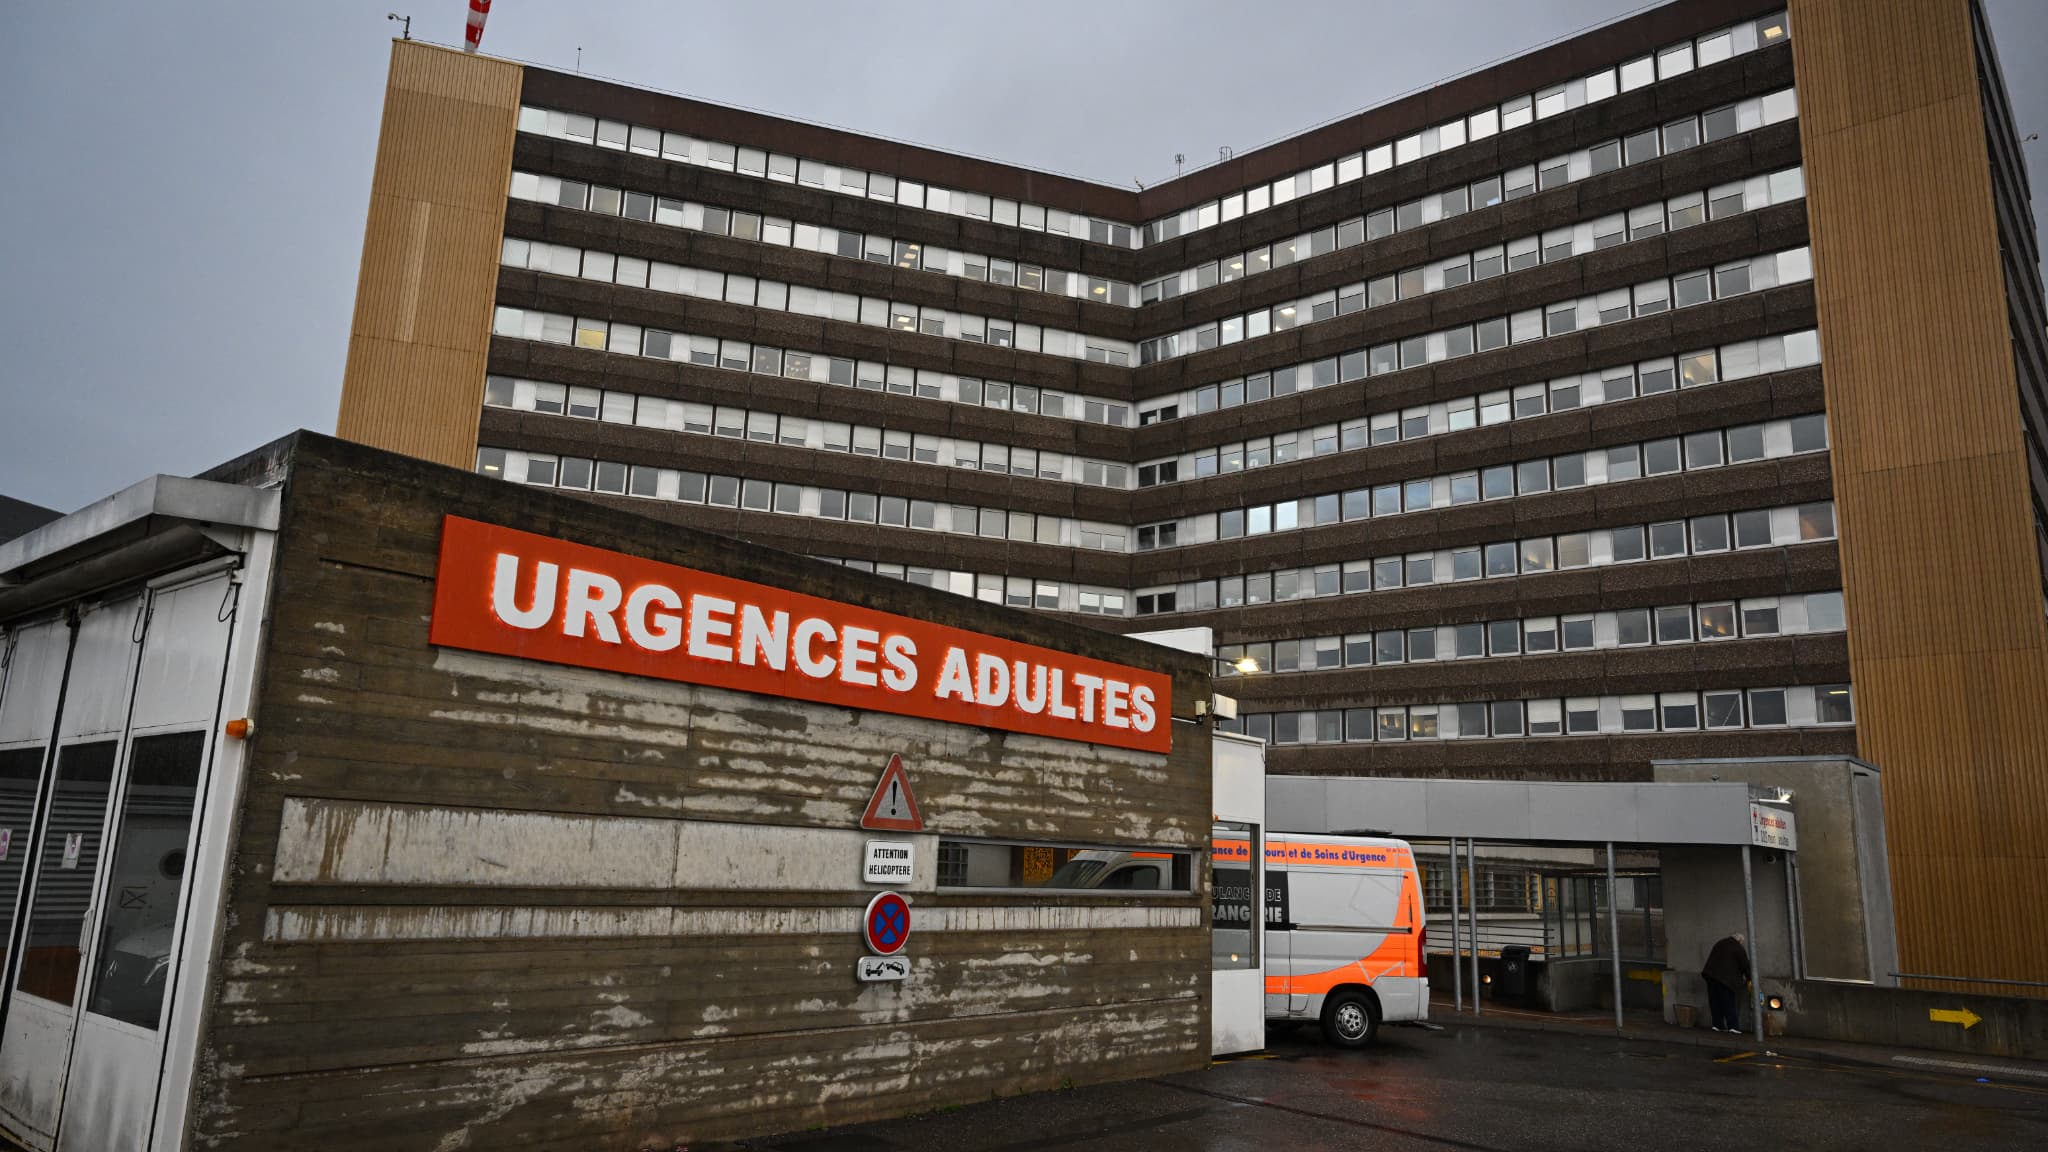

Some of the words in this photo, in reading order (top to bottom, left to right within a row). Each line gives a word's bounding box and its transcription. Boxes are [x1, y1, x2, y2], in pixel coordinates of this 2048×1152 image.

[492, 552, 918, 692] URGENCES
[936, 647, 1157, 733] ADULTES
[873, 848, 908, 859] ATTENTION
[1212, 847, 1231, 856] ance
[1236, 846, 1247, 856] de
[1265, 849, 1286, 858] ours
[1288, 849, 1298, 859] et
[1300, 848, 1313, 860] de
[1314, 850, 1339, 861] Soins
[1341, 851, 1387, 864] d'Urgence
[869, 864, 910, 875] HELICOPTERE
[1212, 886, 1250, 901] ULANC
[1266, 888, 1281, 901] DE
